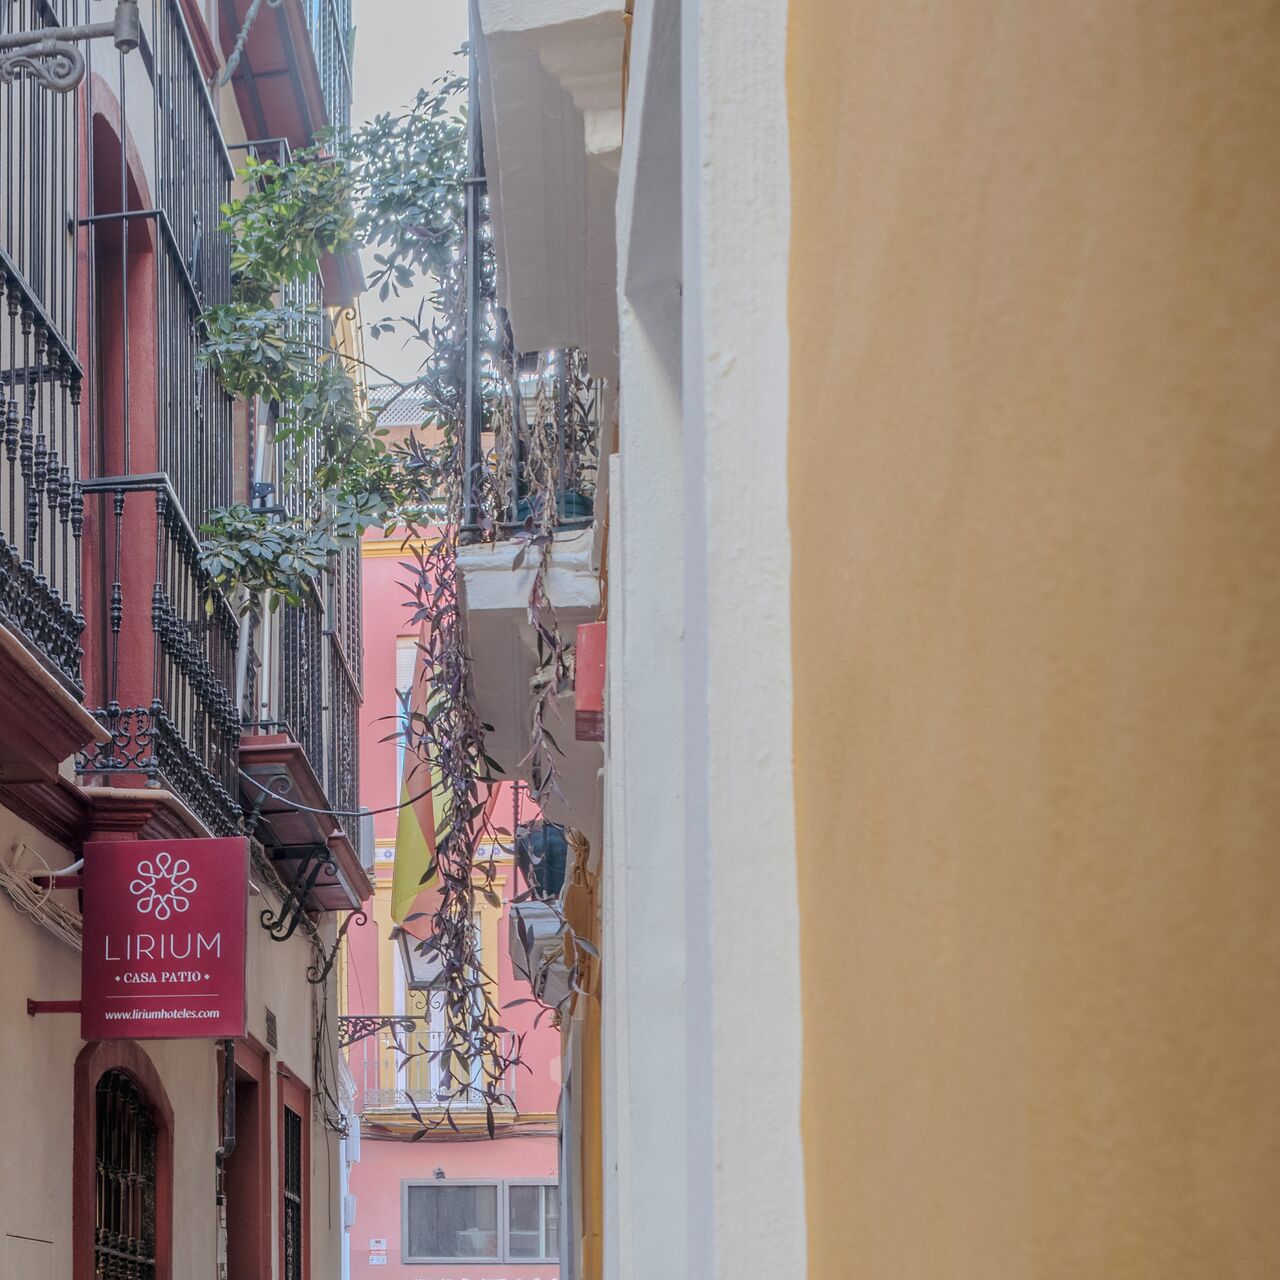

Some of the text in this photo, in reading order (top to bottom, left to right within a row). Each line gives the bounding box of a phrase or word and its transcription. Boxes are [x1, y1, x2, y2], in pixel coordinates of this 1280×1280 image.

[105, 932, 221, 961] LIRIUM
[124, 971, 201, 983] CASA PATIO
[105, 1008, 220, 1021] www.liriumhoteles.com
